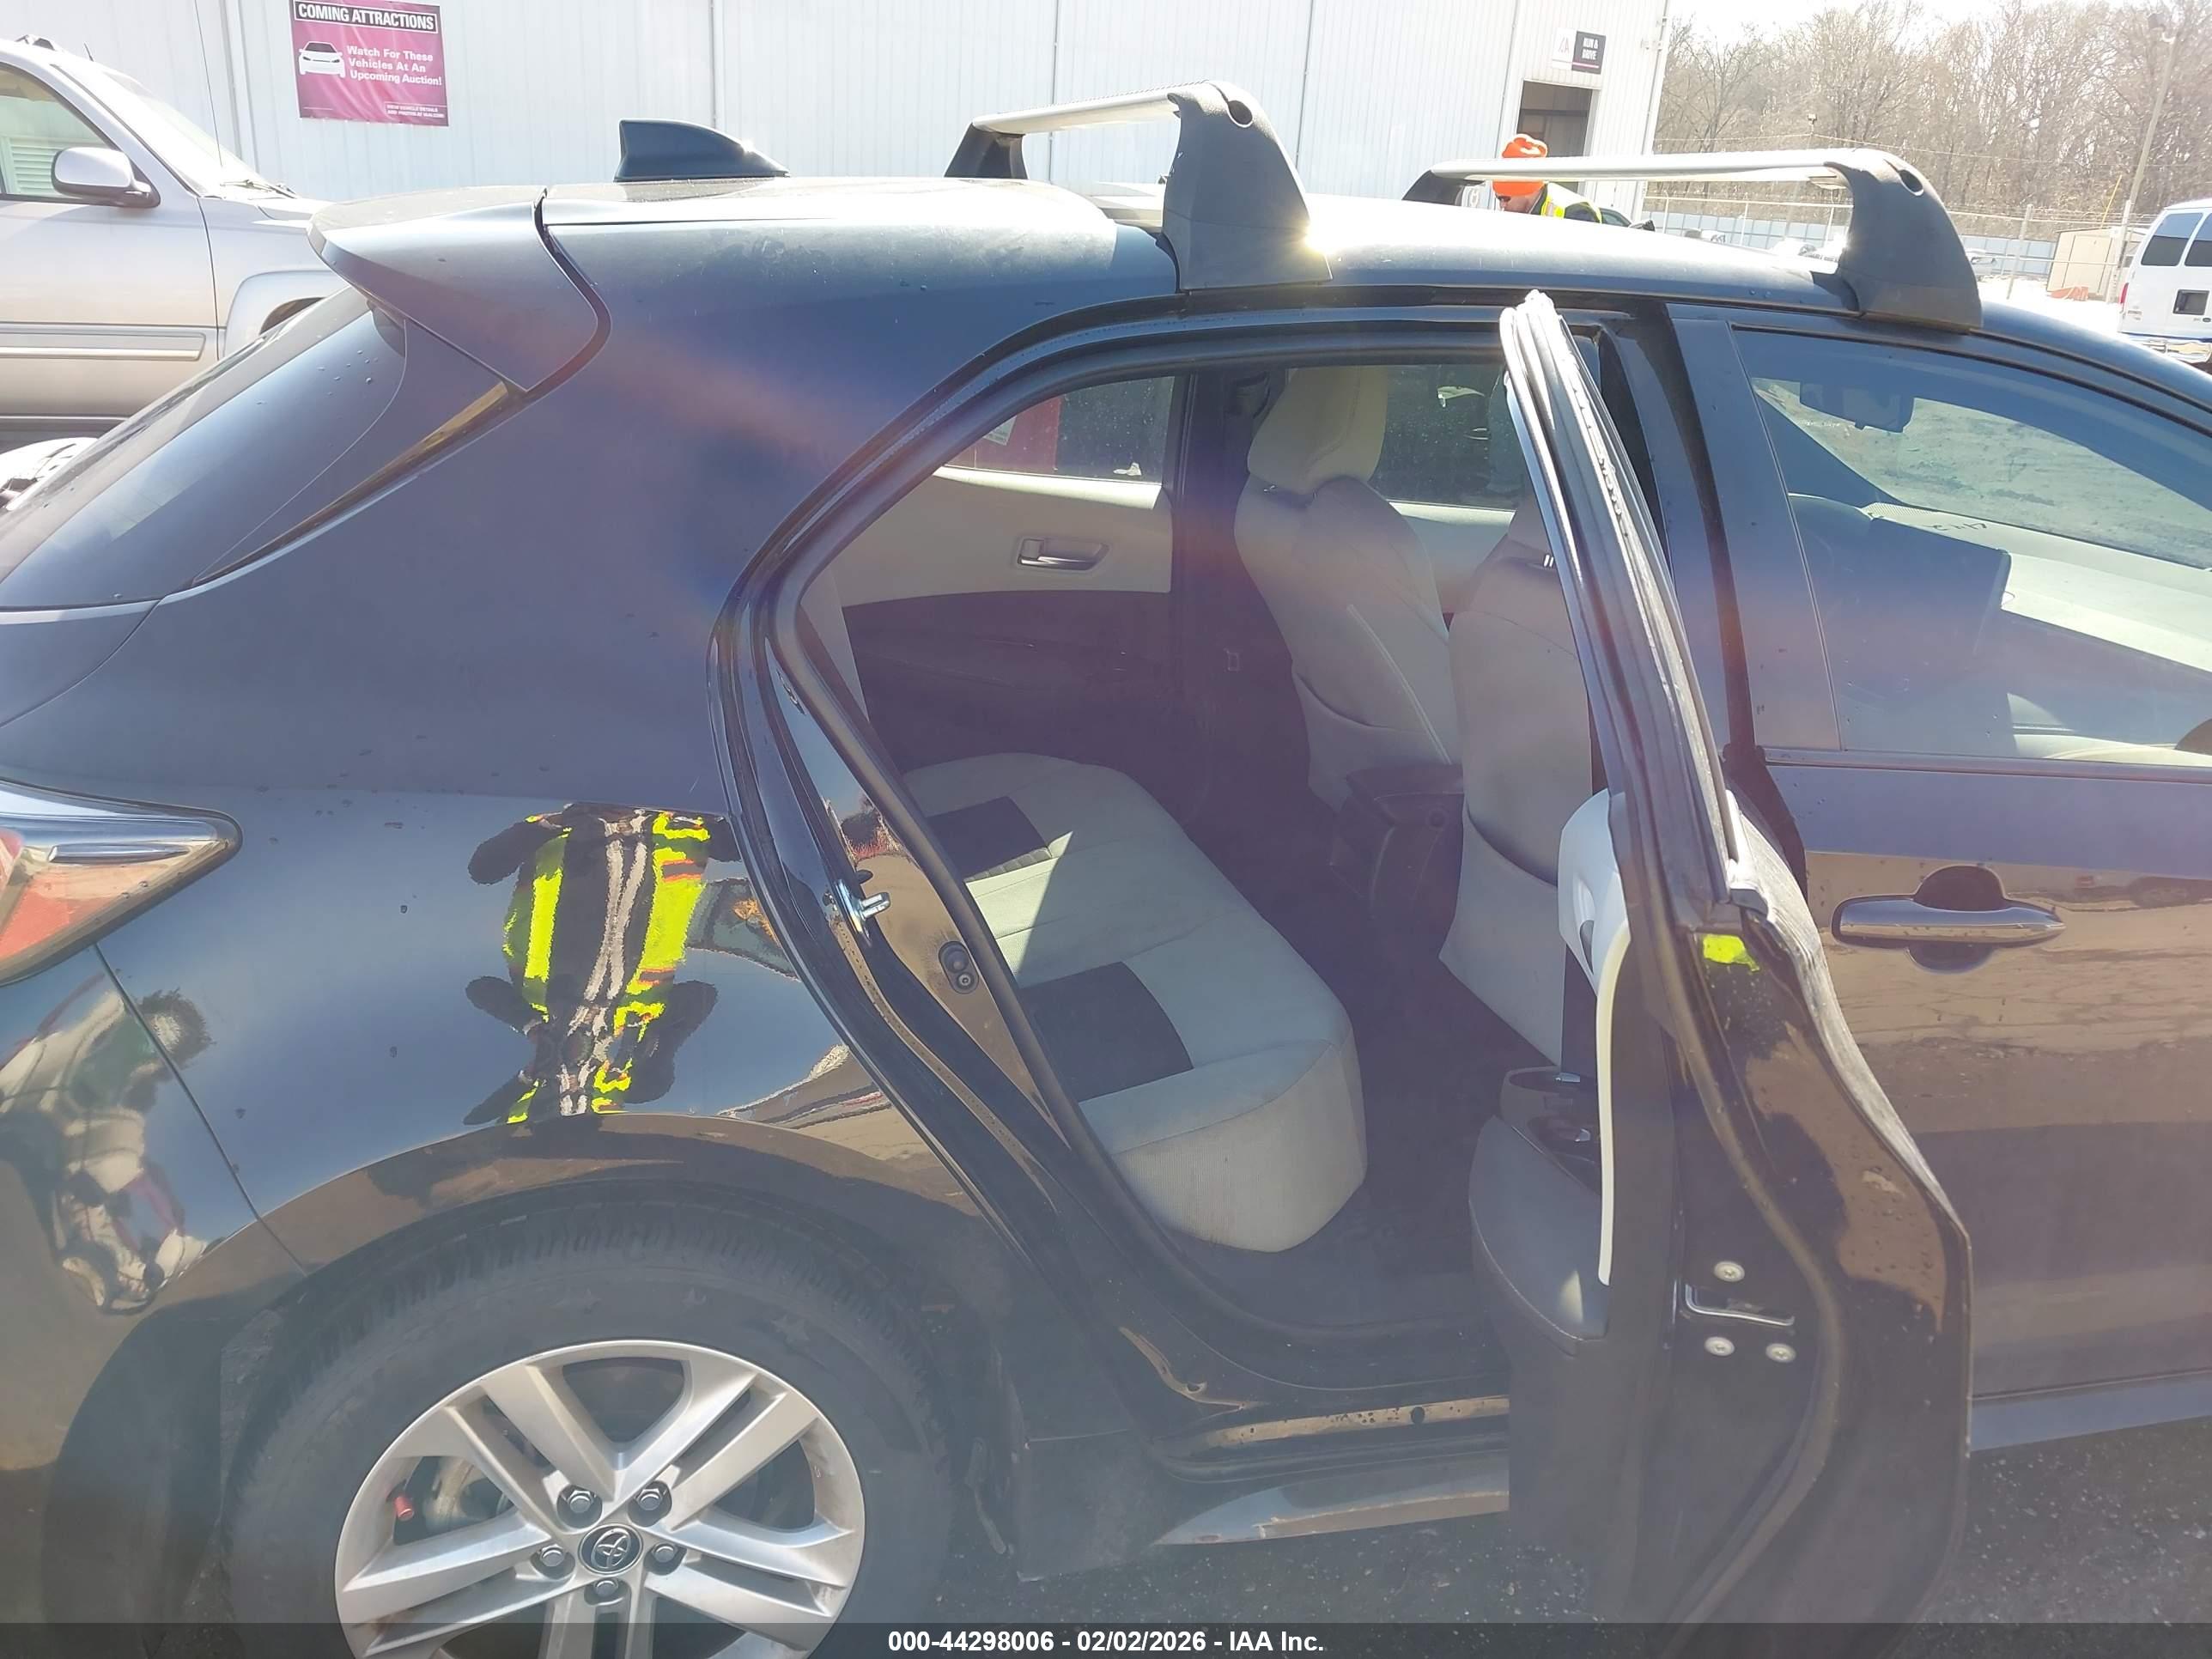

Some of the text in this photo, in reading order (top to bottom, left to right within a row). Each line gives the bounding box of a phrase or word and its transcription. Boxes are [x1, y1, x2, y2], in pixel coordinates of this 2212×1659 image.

[298, 3, 434, 30] COMING ATTRACTIONS
[347, 46, 434, 62] Watch For These
[349, 58, 426, 73] Vehicles At An
[349, 70, 442, 86] Upcoming Auction!
